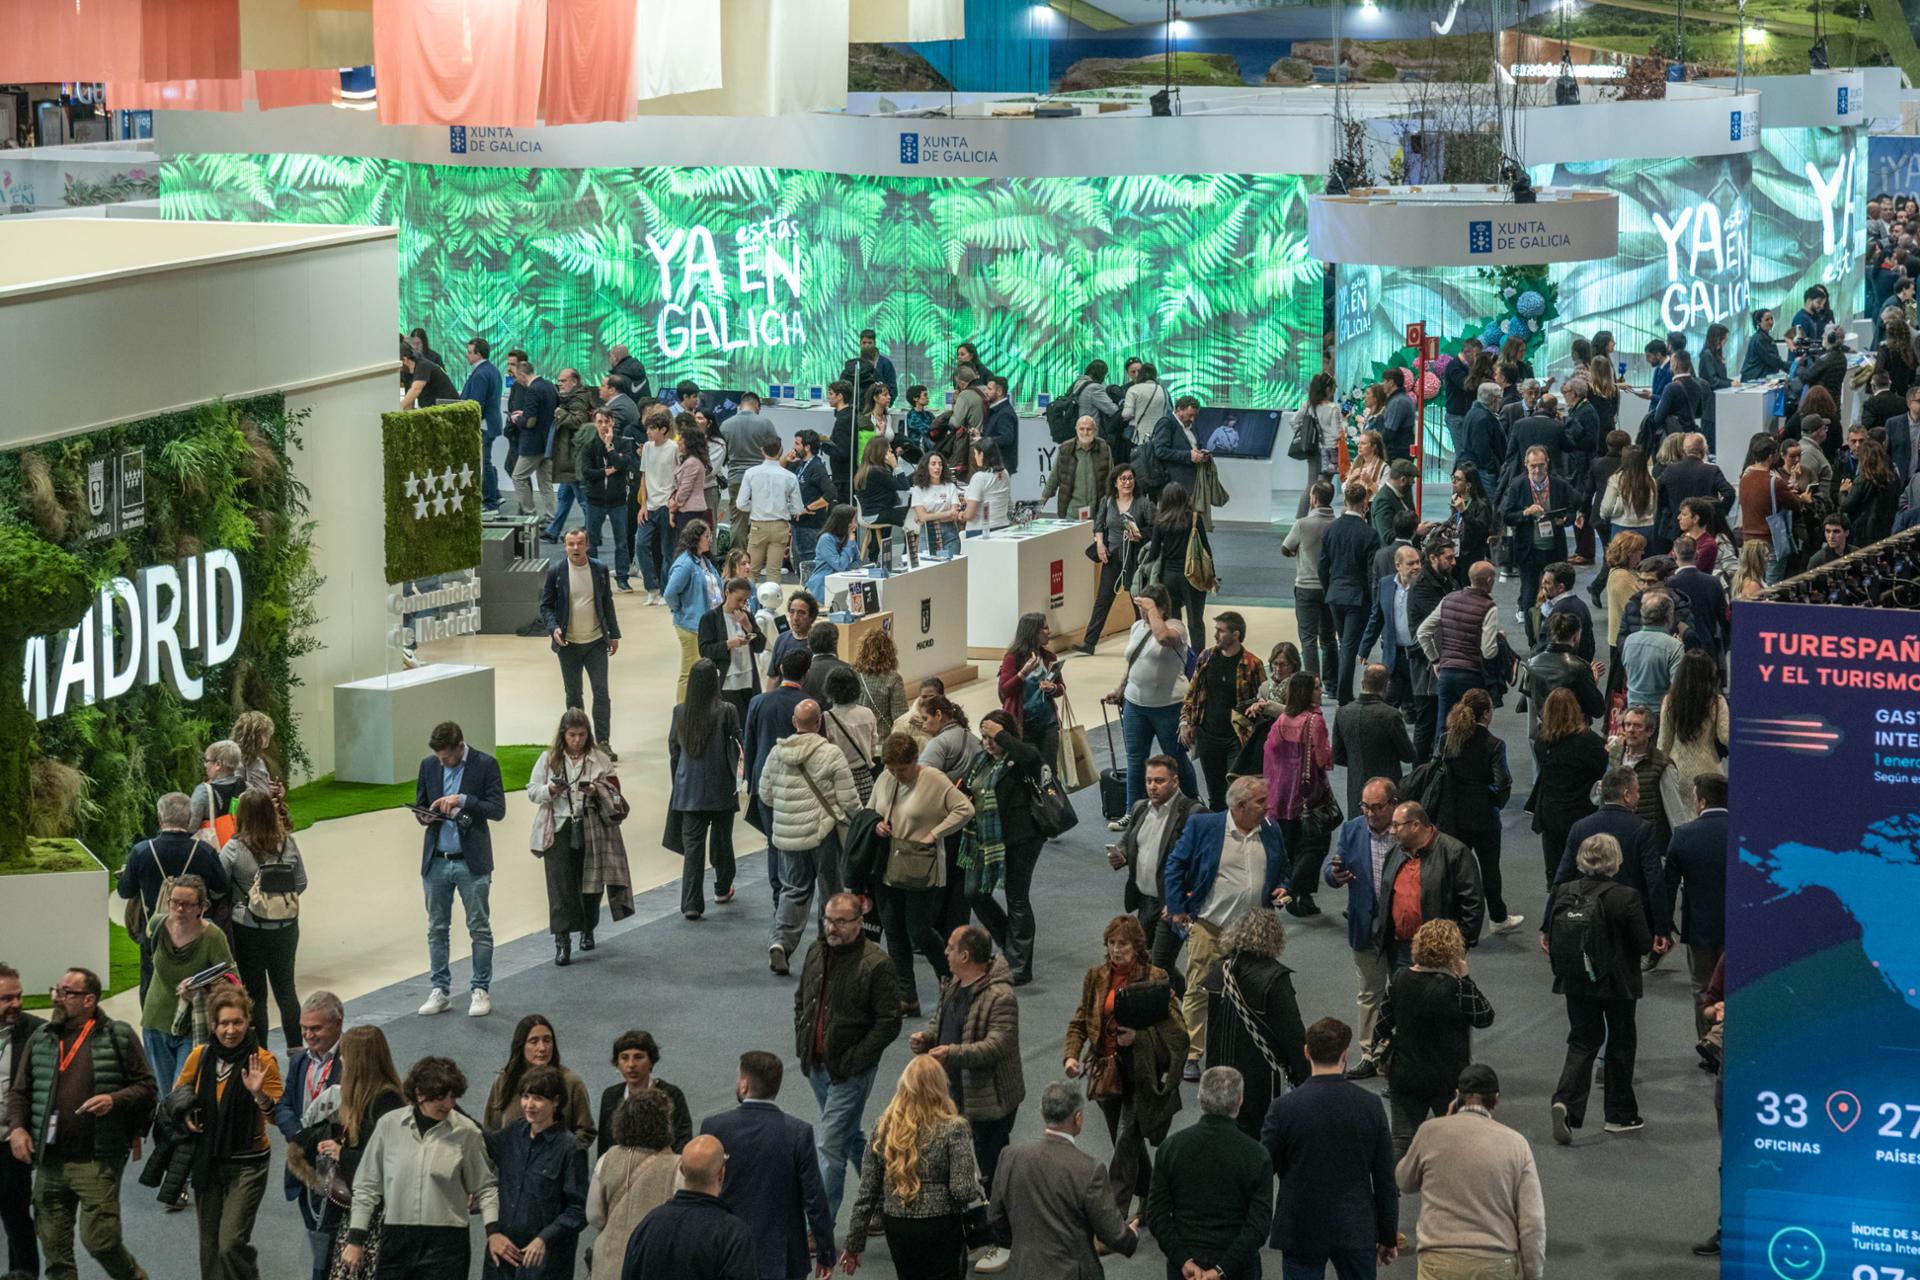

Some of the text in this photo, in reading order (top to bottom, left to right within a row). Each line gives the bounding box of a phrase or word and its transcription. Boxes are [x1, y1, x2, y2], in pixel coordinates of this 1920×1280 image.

[470, 127, 514, 138] XUNTA
[470, 140, 543, 152] DE GALICIA
[923, 136, 968, 148] XUNTA
[922, 150, 998, 163] DE GALICIA
[1498, 221, 1546, 235] XUNTA
[1497, 235, 1571, 250] DE GALICIA
[1652, 202, 1748, 282] YA EN
[645, 225, 801, 307] YA EN
[1351, 287, 1367, 317] EN
[657, 301, 806, 358] GALICIA
[390, 576, 481, 615] Comunidad
[388, 606, 481, 648] de Madrid
[1759, 632, 1920, 663] TURESPAÑ
[1759, 664, 1920, 691] Y EL TURISMO
[1875, 731, 1920, 748] INTE
[1874, 752, 1880, 766] 1
[1874, 771, 1908, 784] Según
[1756, 1091, 1808, 1128] 33
[1878, 1102, 1920, 1139] 27
[1754, 1138, 1821, 1154] OFICINAS
[1851, 1221, 1920, 1241] ÍNDICE DE S
[1851, 1238, 1892, 1252] Turista
